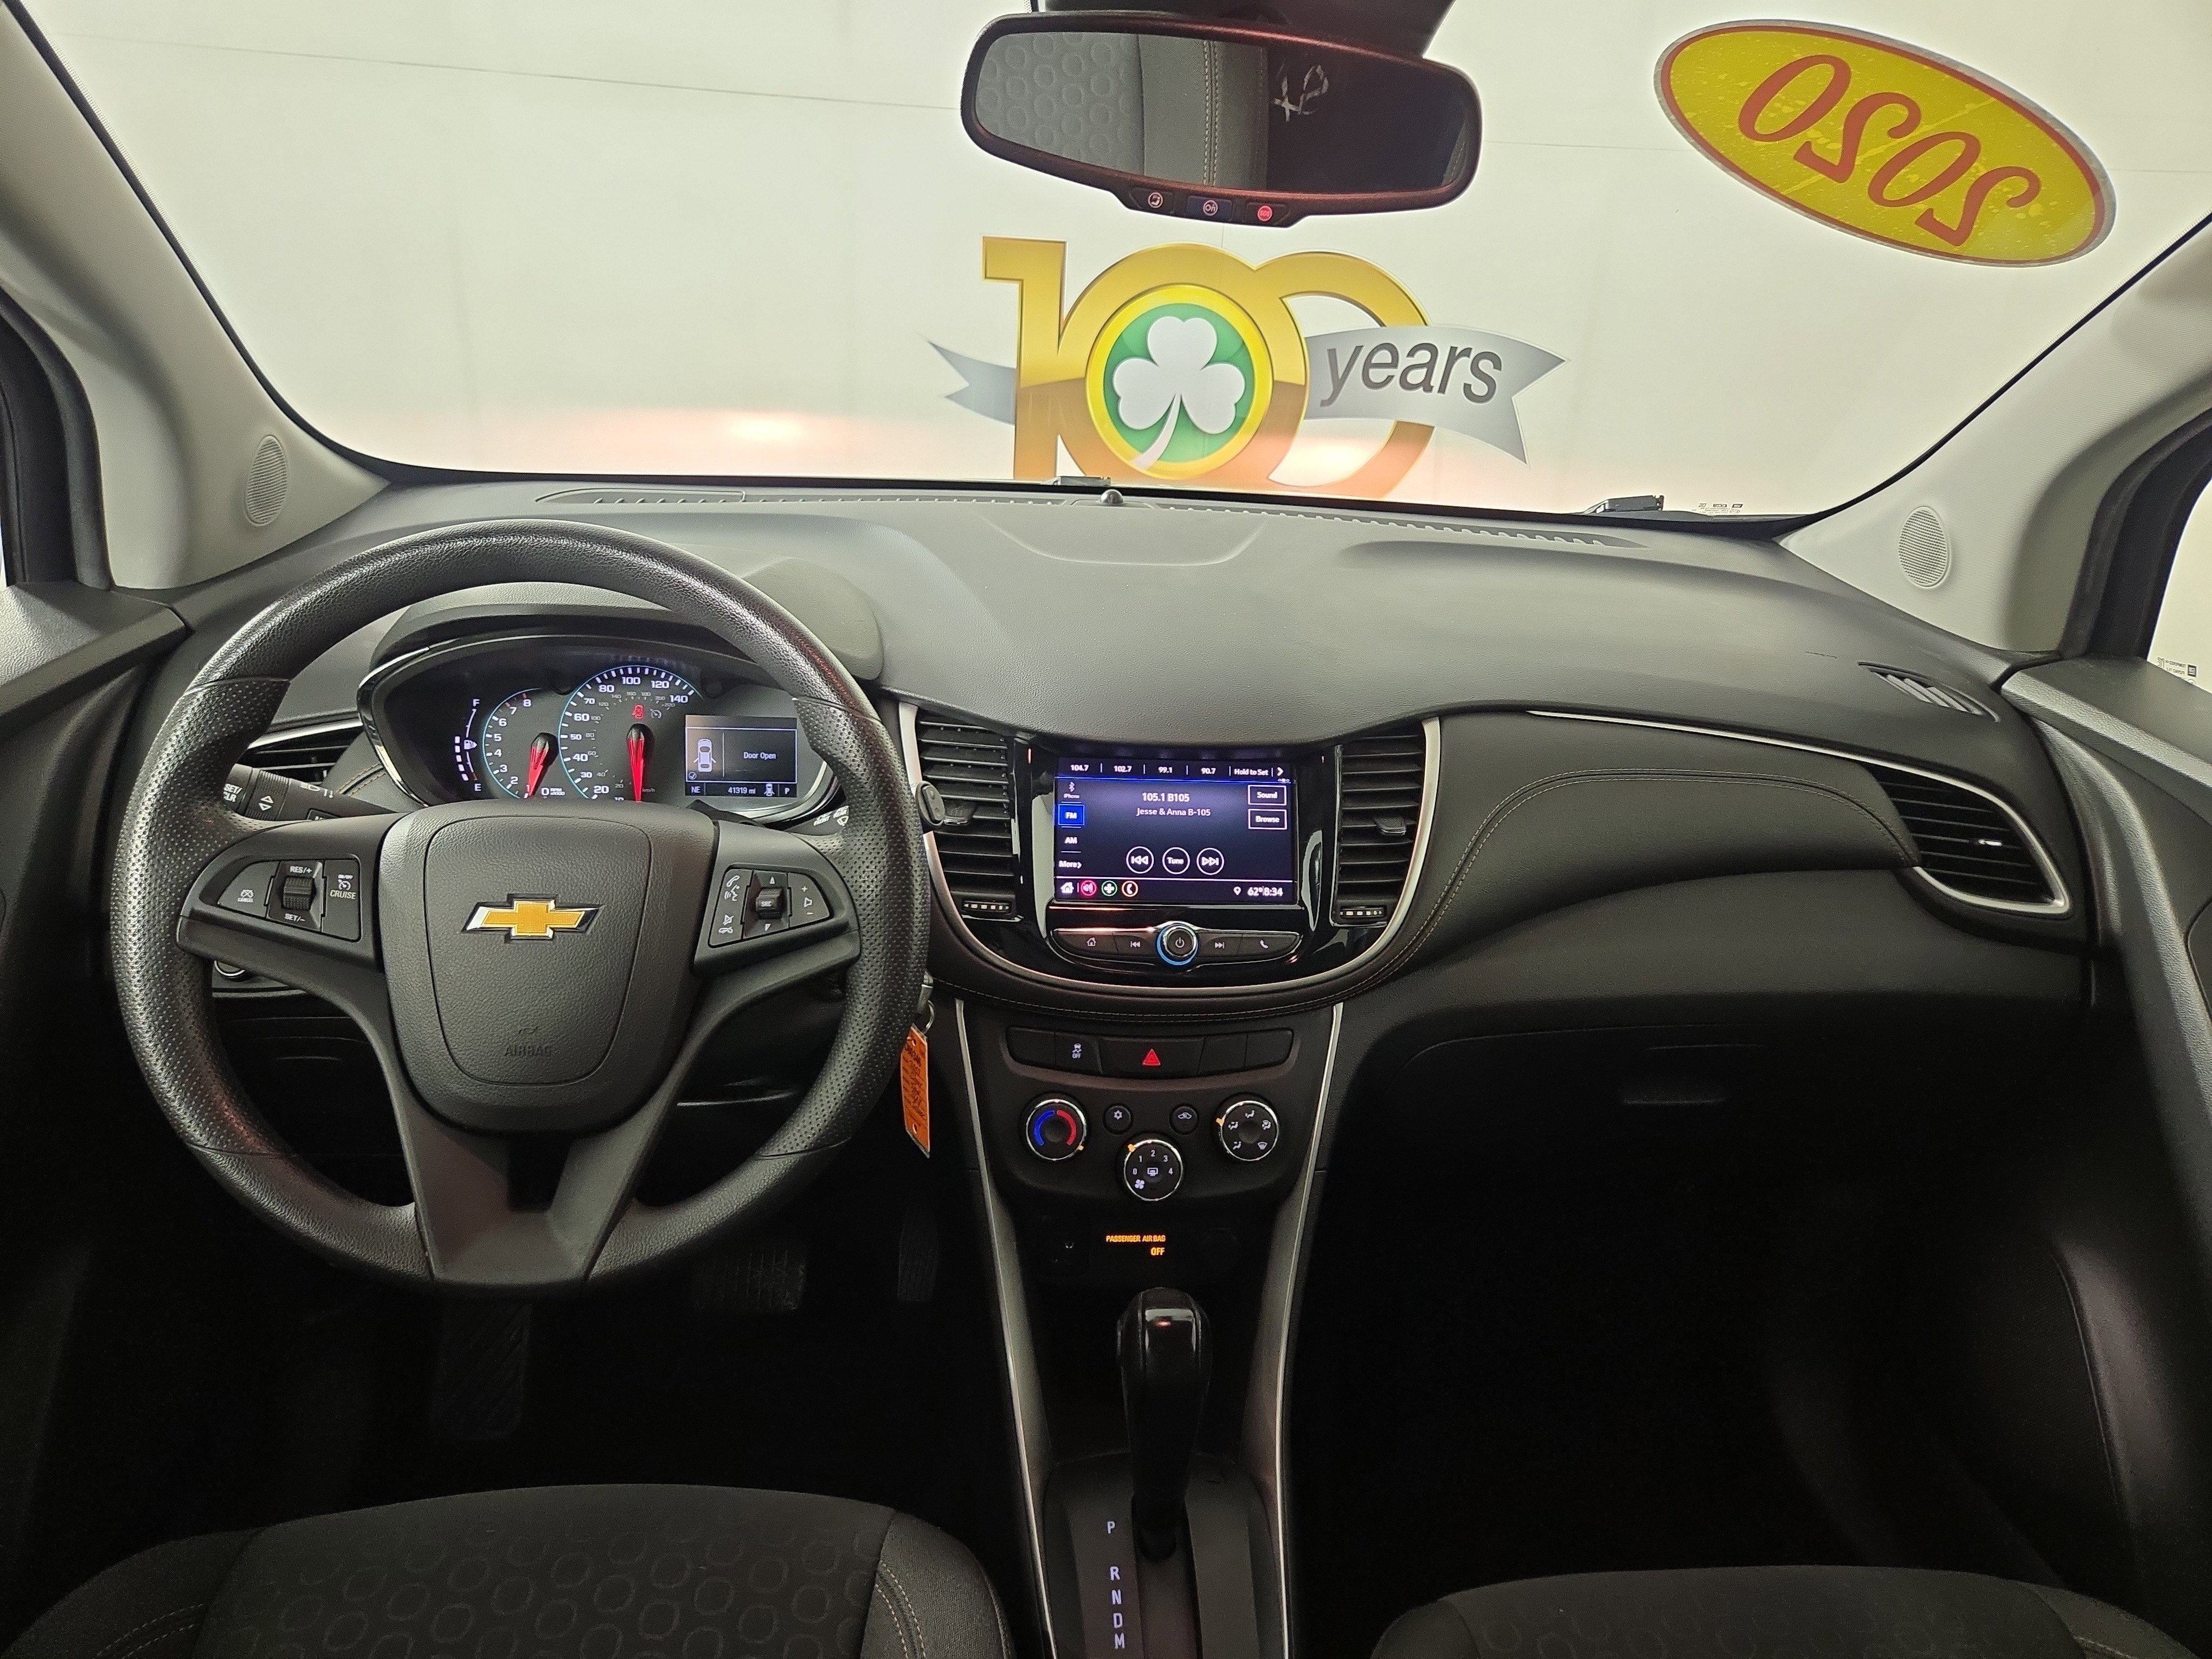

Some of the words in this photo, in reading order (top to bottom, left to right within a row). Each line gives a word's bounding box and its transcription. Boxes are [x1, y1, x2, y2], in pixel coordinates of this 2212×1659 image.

[1320, 342, 1503, 407] years
[622, 677, 641, 685] 100
[651, 680, 670, 689] 120
[599, 685, 615, 693] 80
[473, 698, 480, 706] F
[523, 699, 532, 707] 8
[670, 695, 688, 703] 140
[509, 706, 517, 715] 7
[499, 718, 507, 726] 6
[574, 713, 590, 722] 60
[494, 734, 502, 742] 5
[493, 749, 502, 757] 4
[573, 753, 588, 762] 40
[760, 752, 776, 761] Open
[500, 764, 508, 773] 3
[510, 776, 518, 785] 2
[474, 783, 481, 792] E
[594, 786, 609, 794] 20
[1142, 792, 1165, 802] 105.1
[1167, 793, 1190, 802] B105
[1136, 807, 1158, 816] Jesse
[1187, 808, 1211, 816] B-105
[1167, 856, 1184, 865] Tune
[330, 889, 357, 900] CRUISE
[1264, 887, 1283, 897] 8:34
[1105, 1234, 1141, 1243] PASSENGER
[1150, 1247, 1165, 1256] OFF
[1107, 1520, 1116, 1534] P
[1110, 1565, 1121, 1581] R
[1111, 1589, 1122, 1605] N
[1113, 1612, 1123, 1628] D
[1115, 1632, 1126, 1649] M
